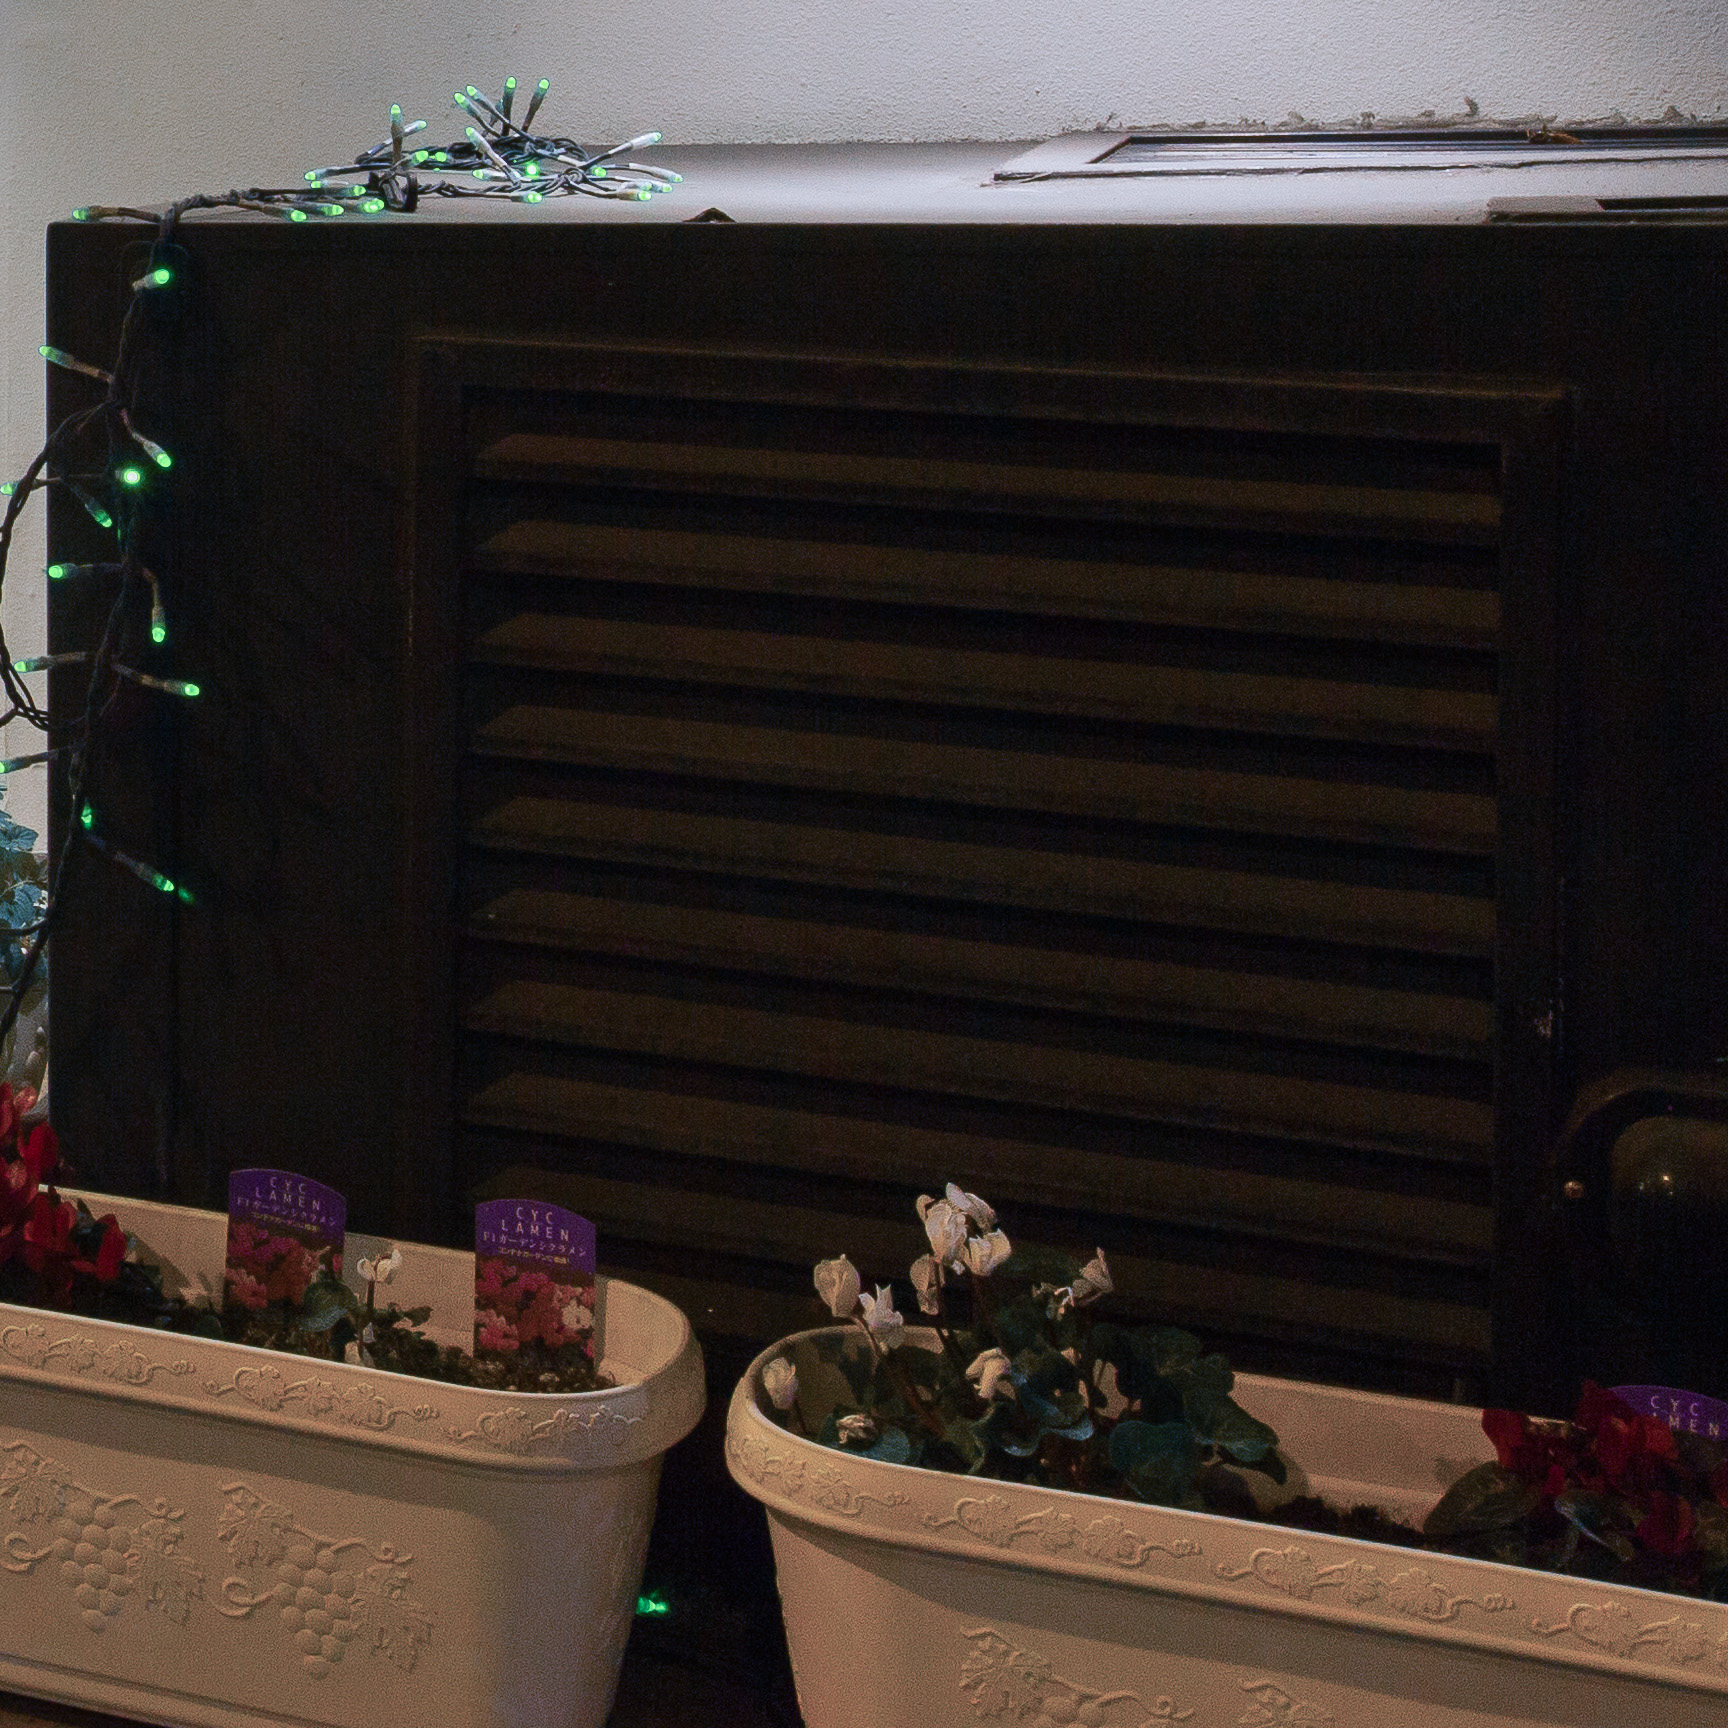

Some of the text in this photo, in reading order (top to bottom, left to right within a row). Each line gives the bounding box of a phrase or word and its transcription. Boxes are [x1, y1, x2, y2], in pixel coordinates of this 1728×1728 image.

[270, 1176, 306, 1195] CYC
[255, 1186, 321, 1210] LAMEN
[516, 1207, 554, 1225] CYC
[501, 1219, 570, 1242] LAMEN
[1650, 1395, 1699, 1417] CYC
